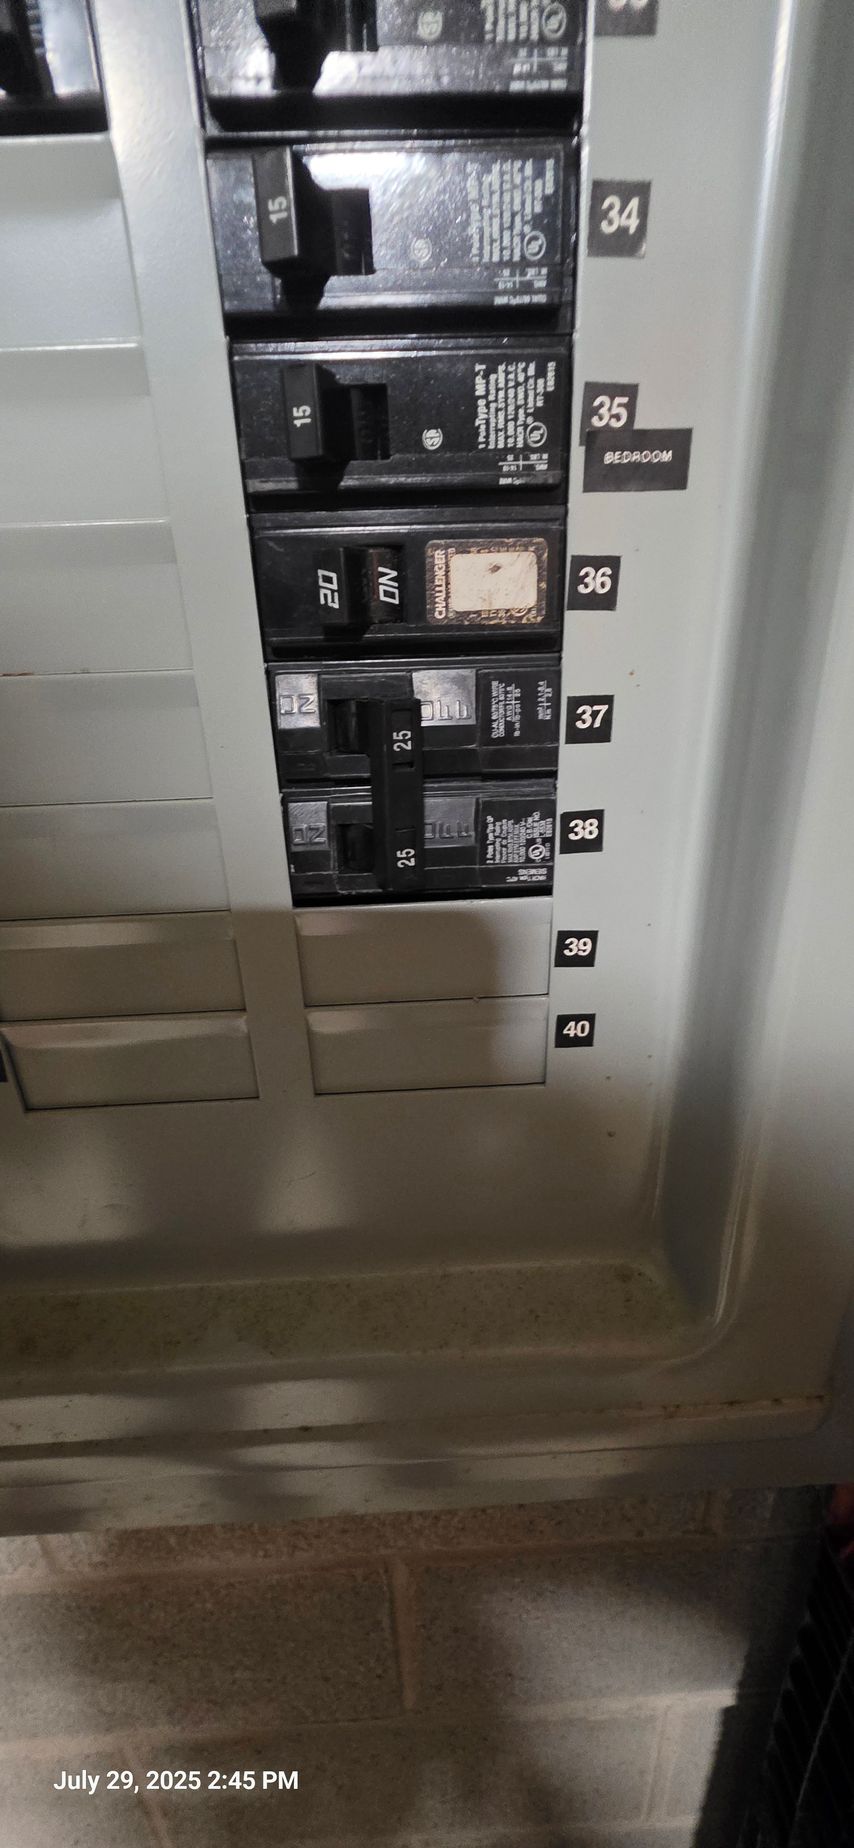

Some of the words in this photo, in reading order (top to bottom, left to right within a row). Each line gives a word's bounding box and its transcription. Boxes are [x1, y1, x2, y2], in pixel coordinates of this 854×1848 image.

[268, 196, 288, 224] 15
[601, 195, 639, 234] 34
[475, 363, 486, 395] MP-T
[293, 405, 311, 428] 15
[591, 395, 629, 428] 35
[488, 403, 497, 449] Interrupting
[603, 450, 673, 464] BEDROOM
[318, 569, 340, 608] 20
[378, 567, 400, 605] ON
[434, 549, 446, 619] CHALLENGER
[577, 567, 612, 594] 36
[575, 705, 608, 729] 37
[393, 730, 412, 751] 25
[568, 819, 599, 840] 38
[397, 848, 415, 868] 25
[563, 937, 593, 956] 39
[562, 1020, 590, 1037] 40
